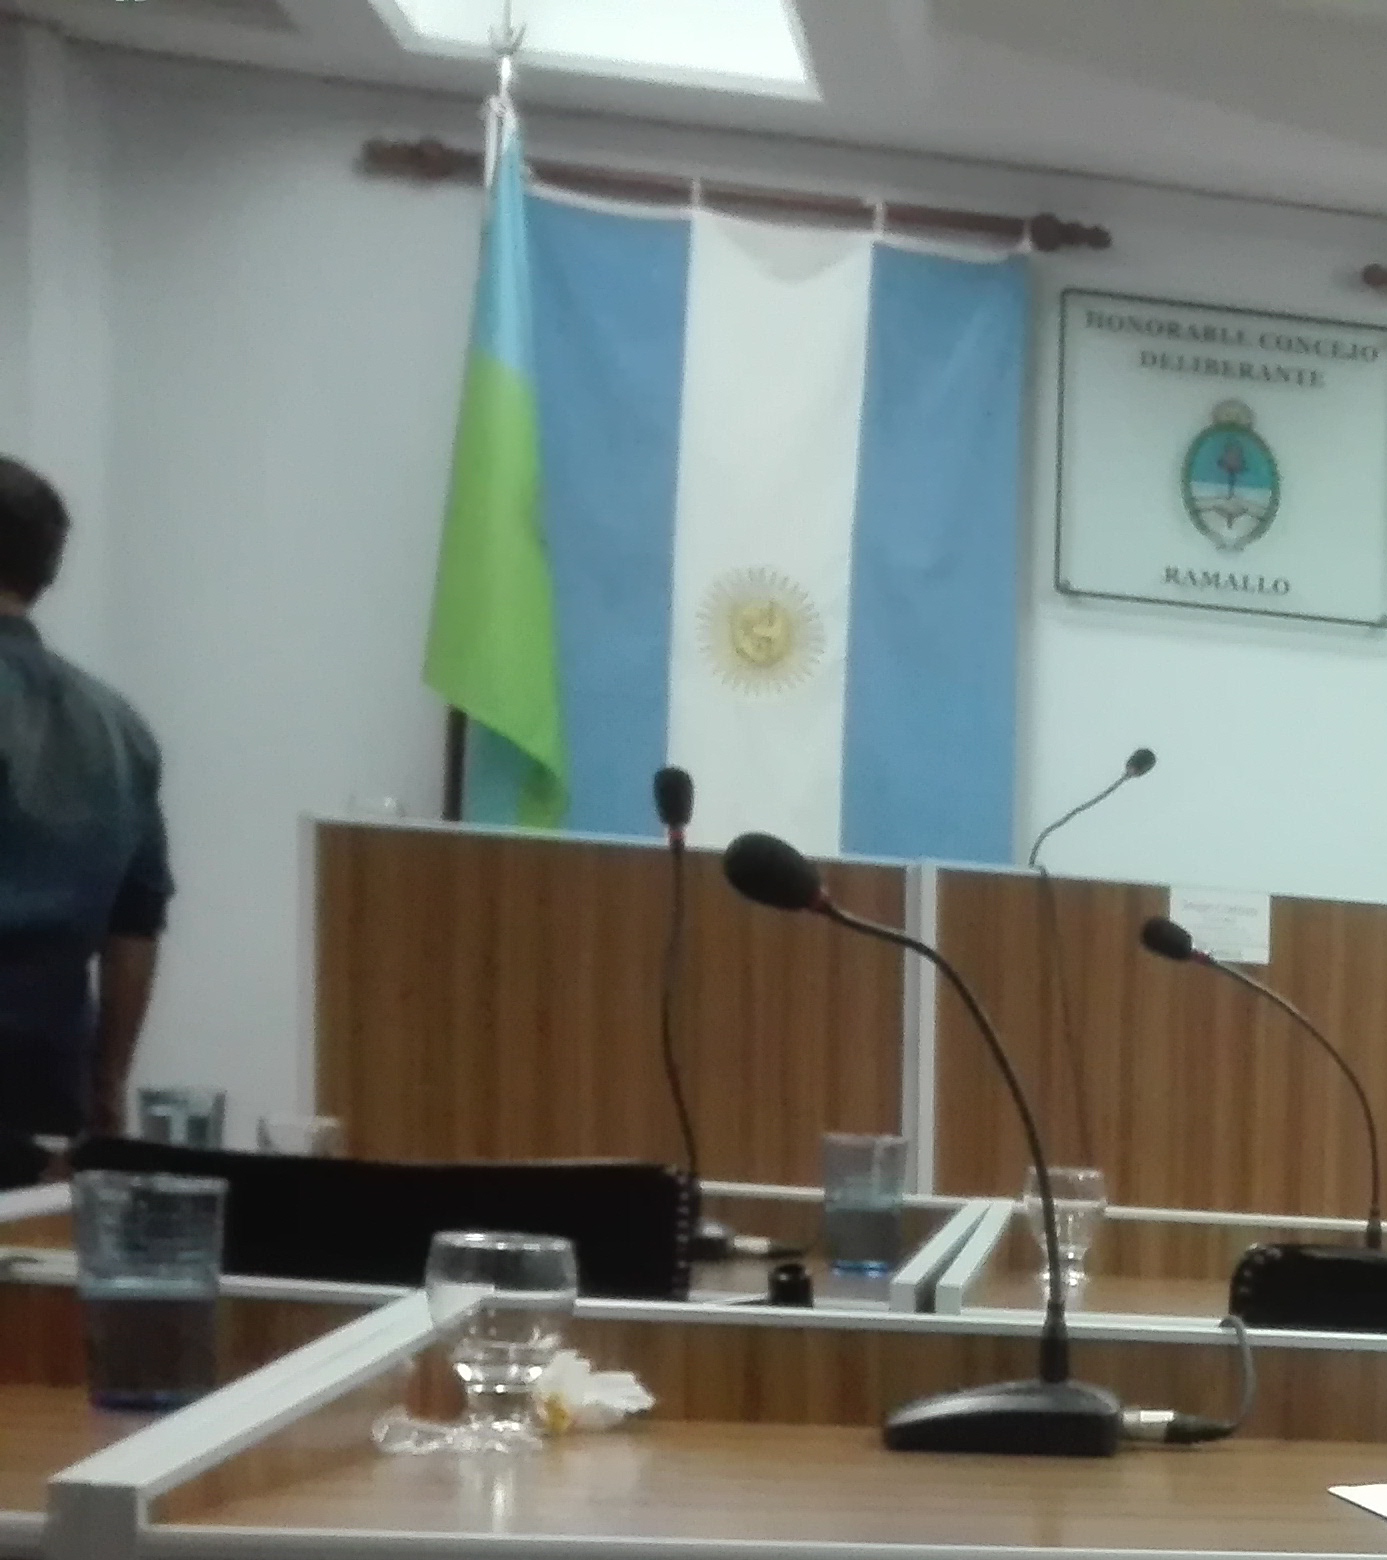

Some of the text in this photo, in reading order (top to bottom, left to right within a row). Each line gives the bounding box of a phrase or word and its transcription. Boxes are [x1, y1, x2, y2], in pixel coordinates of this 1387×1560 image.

[1085, 310, 1379, 363] HONORABLE CONCEJO
[1139, 350, 1324, 388] DELIBERANTE
[1163, 565, 1291, 596] RAMALLO
